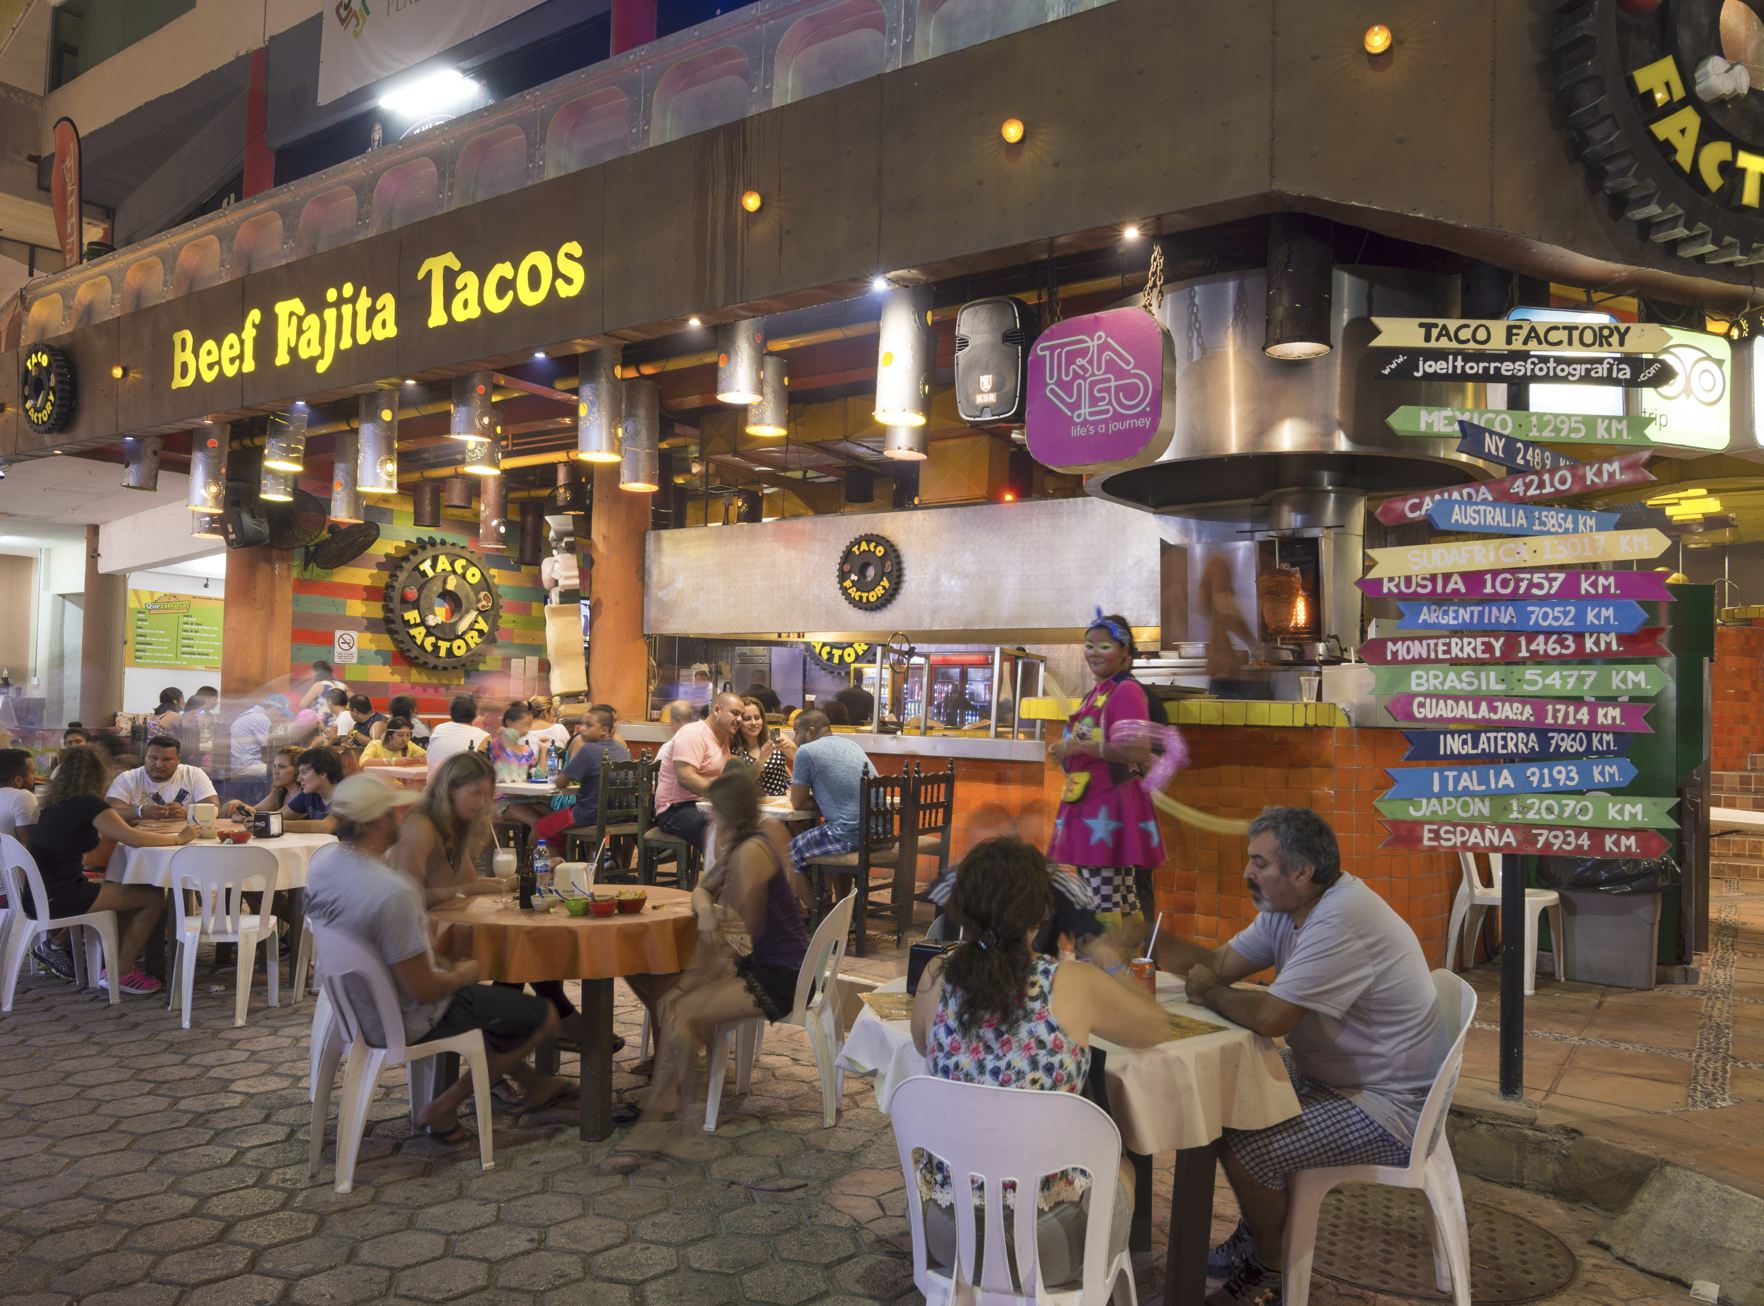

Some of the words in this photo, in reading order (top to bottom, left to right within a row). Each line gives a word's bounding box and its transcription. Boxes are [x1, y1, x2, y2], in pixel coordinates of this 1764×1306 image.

[171, 308, 262, 390] Beef
[275, 281, 399, 374] Fajita
[417, 240, 586, 330] Tacos
[1418, 321, 1491, 346] TACO
[1505, 323, 1632, 348] FACTORY
[26, 351, 49, 371] TACO
[1071, 422, 1095, 437] life's
[1098, 424, 1105, 433] a
[1108, 417, 1152, 435] journey
[1529, 415, 1586, 439] 1295
[1596, 418, 1632, 441] KM.
[1516, 442, 1551, 470] 2489
[1510, 470, 1572, 497] 4210
[1585, 460, 1625, 485] KM.
[1451, 504, 1527, 528] AUSTRALIA
[1532, 511, 1574, 533] 15854
[852, 541, 885, 557] TACO
[1408, 542, 1530, 570] SUDAFRICA
[1543, 536, 1606, 561] 13017
[418, 554, 481, 585] TACO
[843, 576, 890, 603] FACTORY
[1383, 575, 1466, 594] RUSIA
[1483, 572, 1566, 595] 10757
[1580, 575, 1621, 594] KM.
[1418, 606, 1517, 625] ARGENTINA
[1526, 606, 1576, 626] 7052
[1586, 606, 1619, 625] KM.
[403, 609, 489, 657] FACTORY
[1386, 635, 1505, 661] MONTERREY
[1517, 633, 1576, 657] 1463
[1584, 631, 1624, 653] KM.
[1410, 670, 1507, 691] BRASIL
[1522, 669, 1598, 691] 5477
[1611, 671, 1652, 690] KM.
[1412, 697, 1535, 722] GUADALAJARA
[1545, 704, 1590, 726] 1714
[1597, 706, 1626, 726] KM.
[1439, 732, 1539, 755] INGLATERRA
[1547, 732, 1587, 753] 7960
[1592, 732, 1618, 751] KM.
[1433, 768, 1515, 792] ITALIA
[1526, 766, 1579, 788] 9193
[1592, 764, 1624, 783] KM.
[1508, 798, 1594, 821] 12070
[1607, 802, 1649, 822] KM.
[1422, 825, 1517, 847] ESPAÑA
[1531, 829, 1592, 850] 7934
[1604, 833, 1641, 853] KM.
